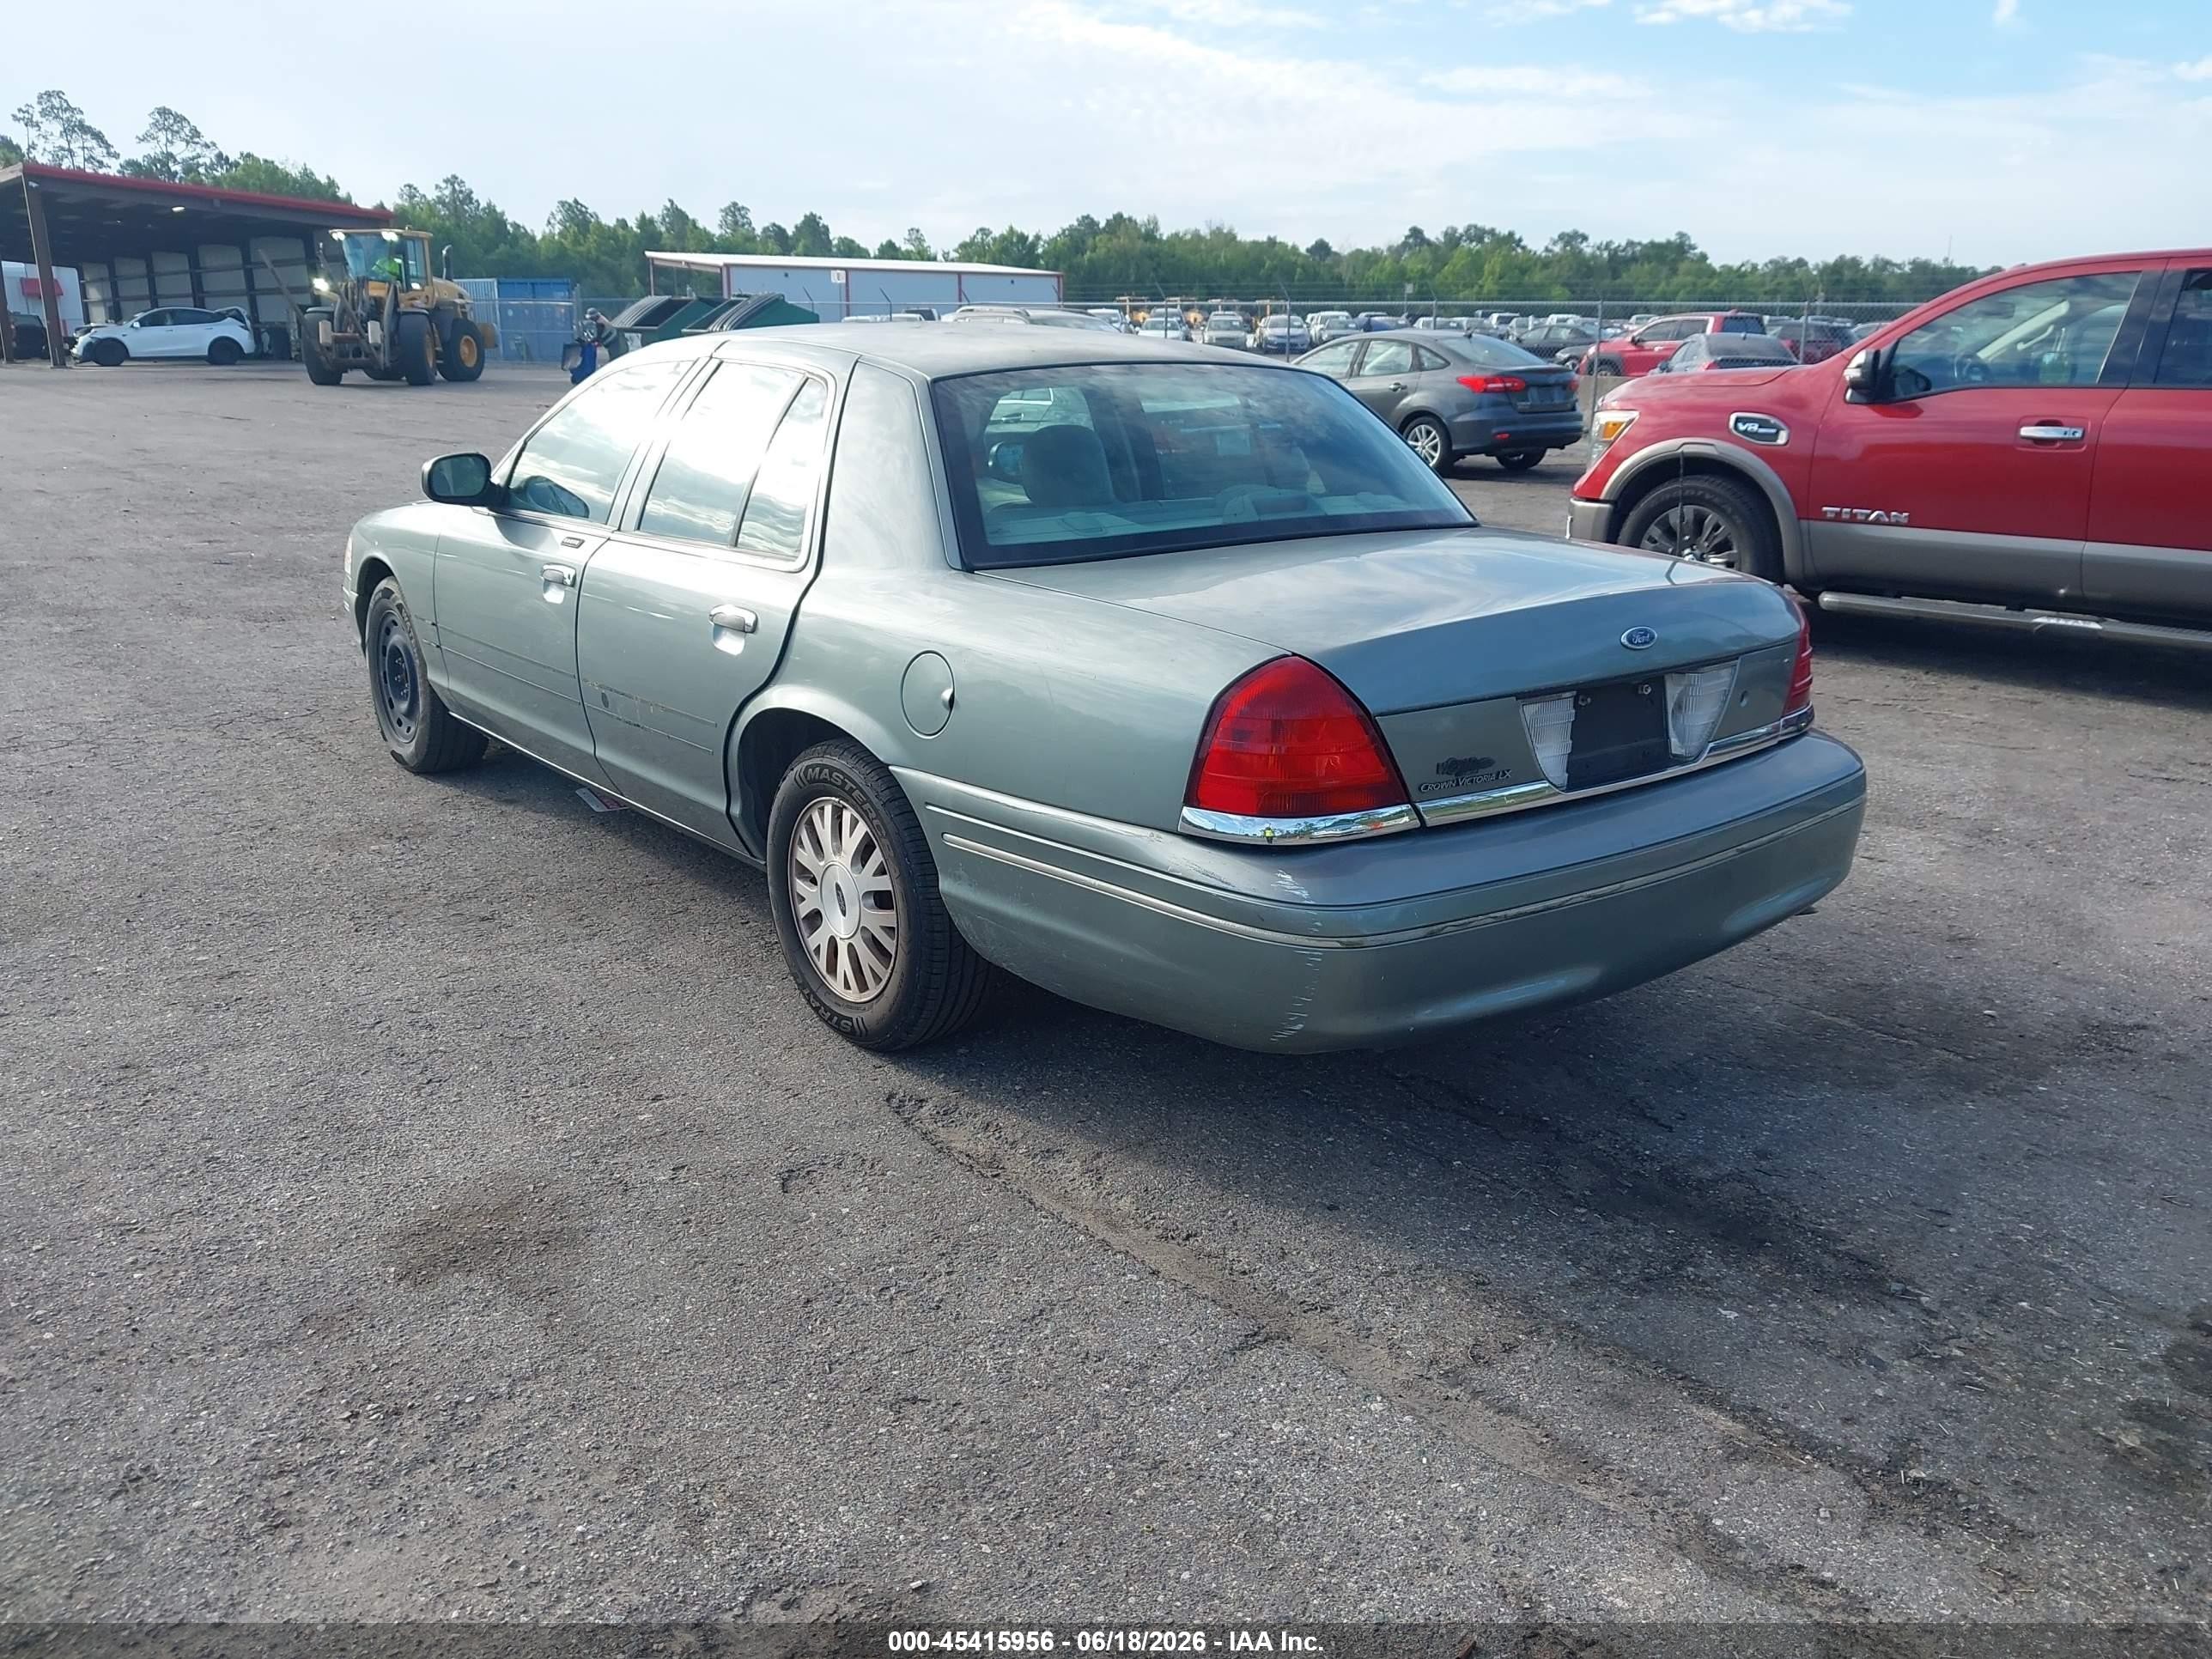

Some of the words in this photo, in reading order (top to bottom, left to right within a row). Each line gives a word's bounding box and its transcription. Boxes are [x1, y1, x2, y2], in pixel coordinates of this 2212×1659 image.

[1736, 422, 1759, 433] V8
[1821, 506, 1910, 523] TITAN
[1419, 780, 1456, 793] CROWN
[1458, 772, 1497, 786] VICTORIA
[1498, 769, 1512, 781] LX
